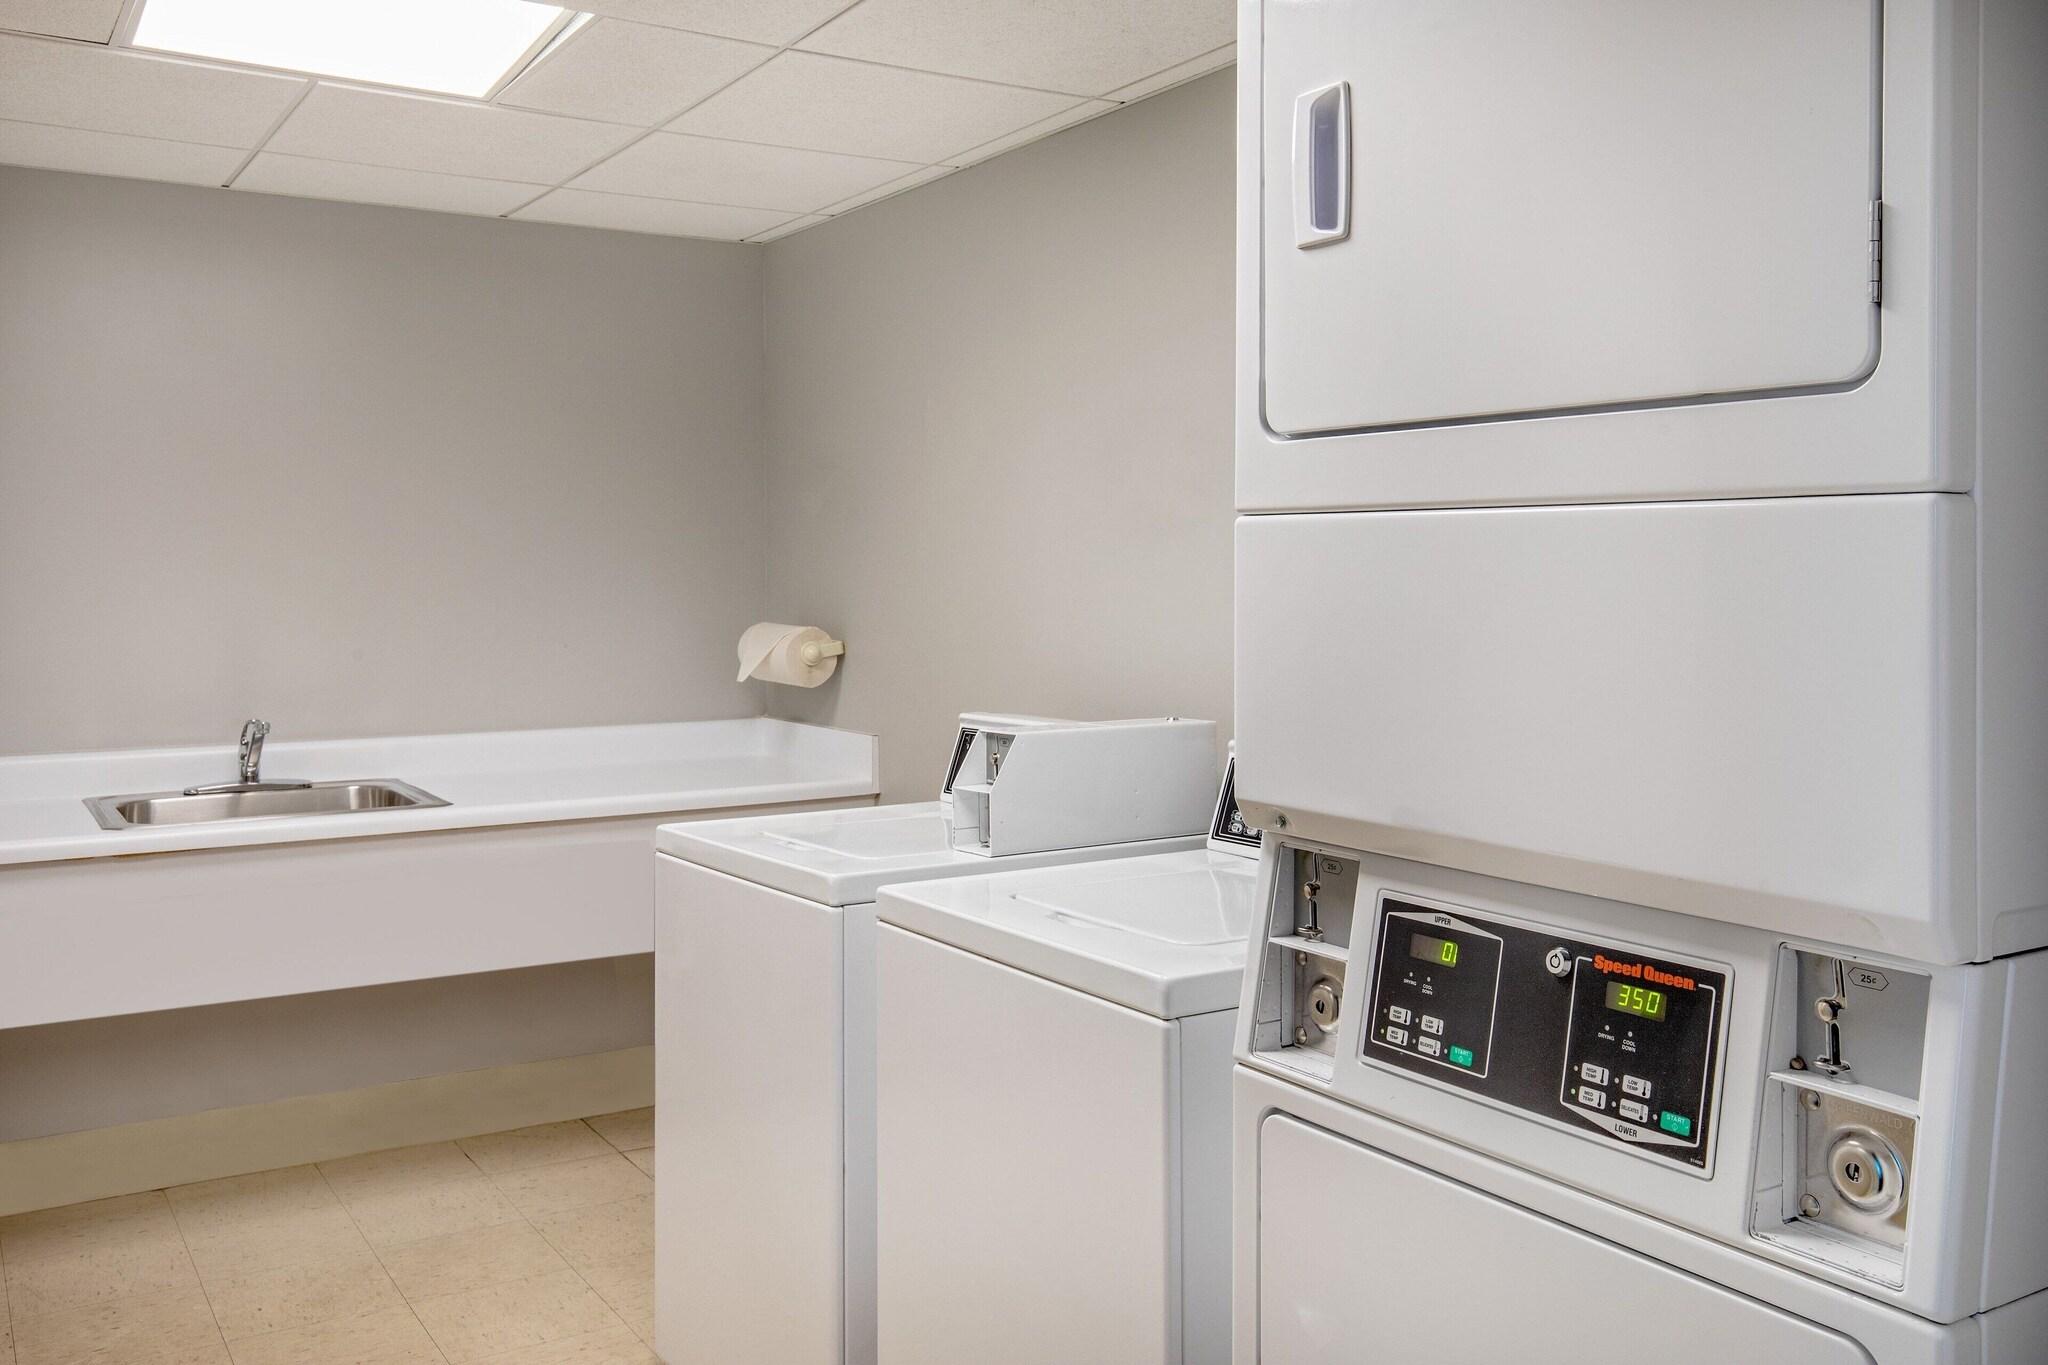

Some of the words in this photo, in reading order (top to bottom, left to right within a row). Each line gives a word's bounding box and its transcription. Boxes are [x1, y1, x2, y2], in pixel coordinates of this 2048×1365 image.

[1434, 915, 1451, 926] UPPER
[1594, 954, 1642, 978] Speed
[1644, 965, 1696, 991] Queen
[1422, 983, 1433, 991] COOL
[1421, 988, 1433, 996] DOWN
[1618, 985, 1660, 1013] 350
[1597, 1032, 1615, 1041] DRYING
[1622, 1039, 1636, 1047] COOL
[1454, 1047, 1469, 1056] START
[1621, 1044, 1636, 1053] DOWN
[1586, 1066, 1597, 1074] HIGH
[1585, 1071, 1597, 1079] TEMP
[1626, 1083, 1639, 1092] TEMP
[1584, 1090, 1594, 1098] MED
[1582, 1095, 1594, 1103] TEMP
[1666, 1114, 1685, 1124] START
[1614, 1123, 1638, 1138] LOWER
